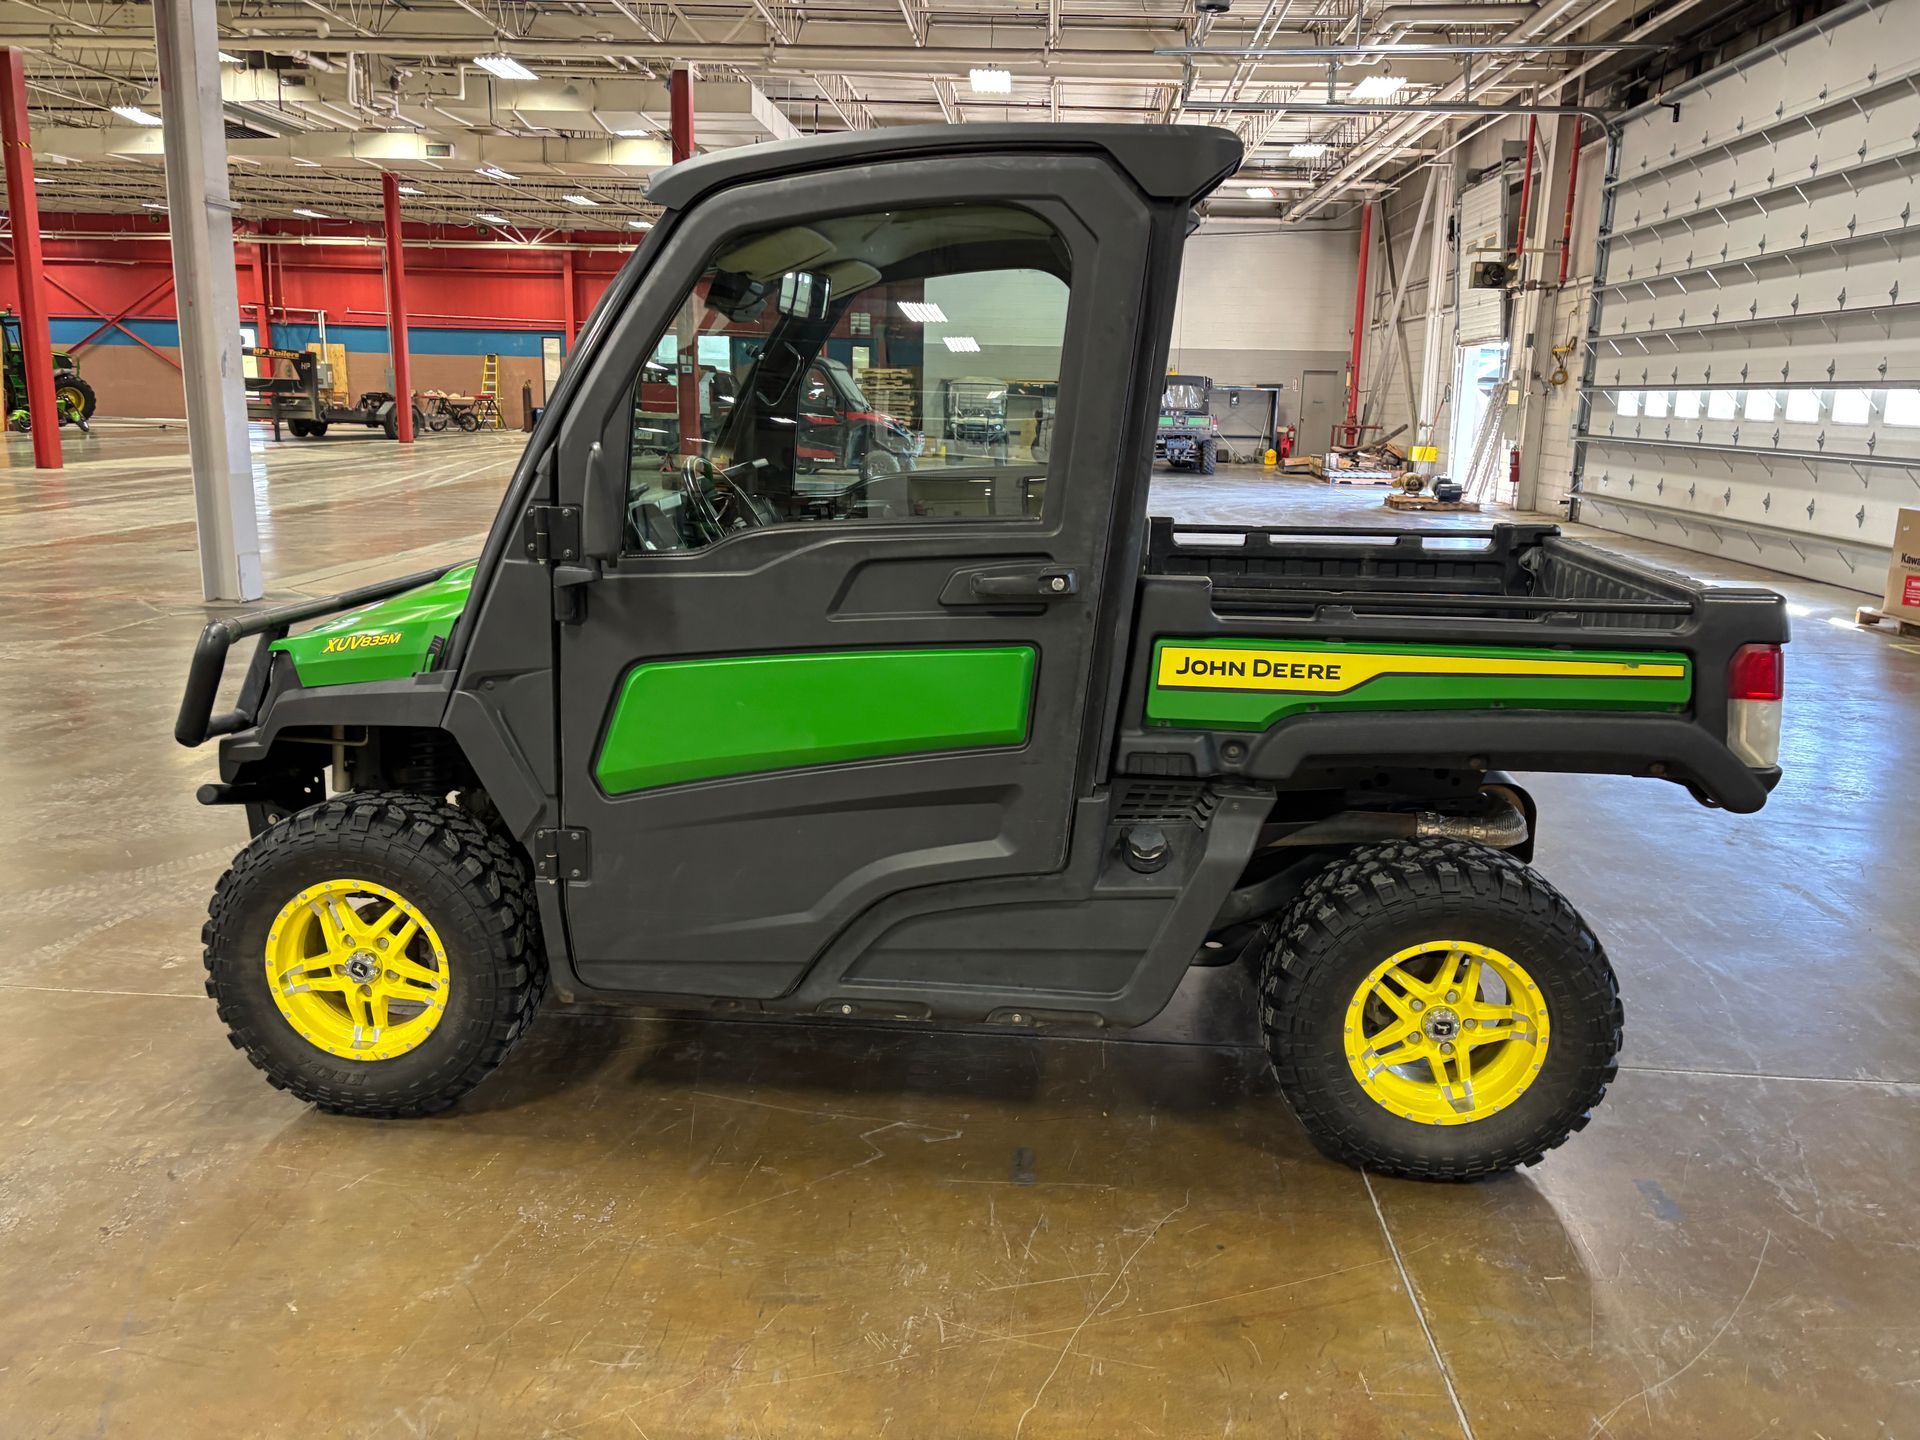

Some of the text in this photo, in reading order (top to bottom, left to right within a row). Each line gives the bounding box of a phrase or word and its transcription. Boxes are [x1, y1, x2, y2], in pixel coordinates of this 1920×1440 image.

[269, 348, 300, 358] Trailers
[322, 632, 402, 654] XUV835M
[1175, 656, 1342, 681] JOHN DEERE
